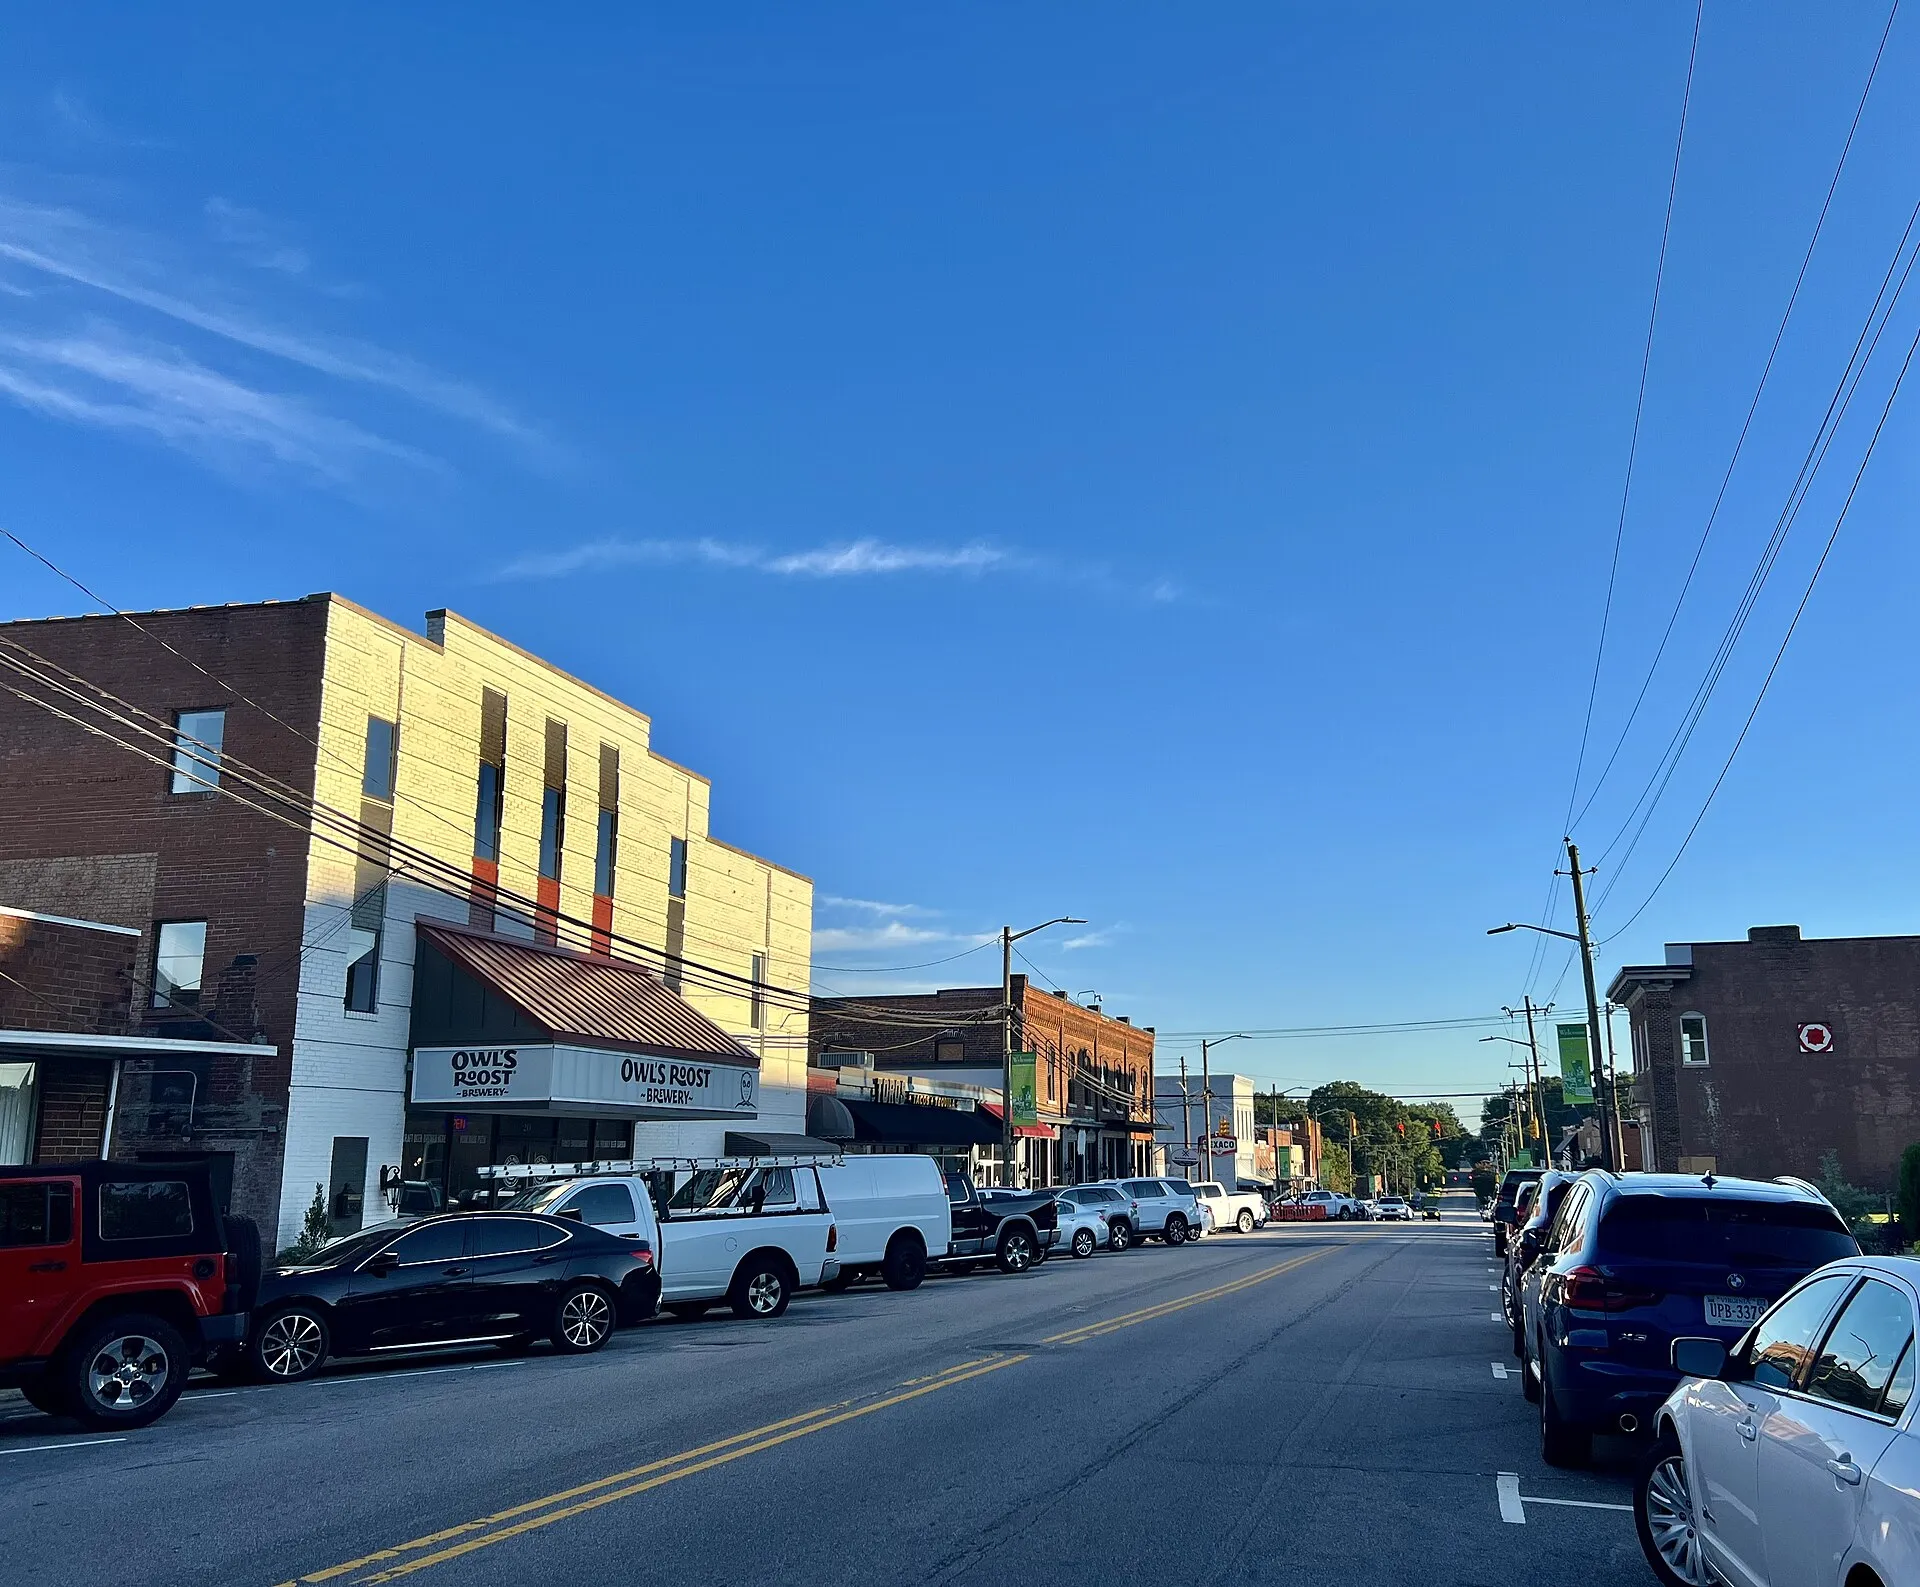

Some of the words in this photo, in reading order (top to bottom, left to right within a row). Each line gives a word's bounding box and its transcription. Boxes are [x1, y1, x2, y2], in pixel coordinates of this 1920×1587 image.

[451, 1049, 517, 1071] OWL'S
[453, 1070, 513, 1087] ROOST
[621, 1059, 665, 1085] OWL'S
[669, 1065, 711, 1088] ROOST
[1210, 1141, 1234, 1149] EXACO
